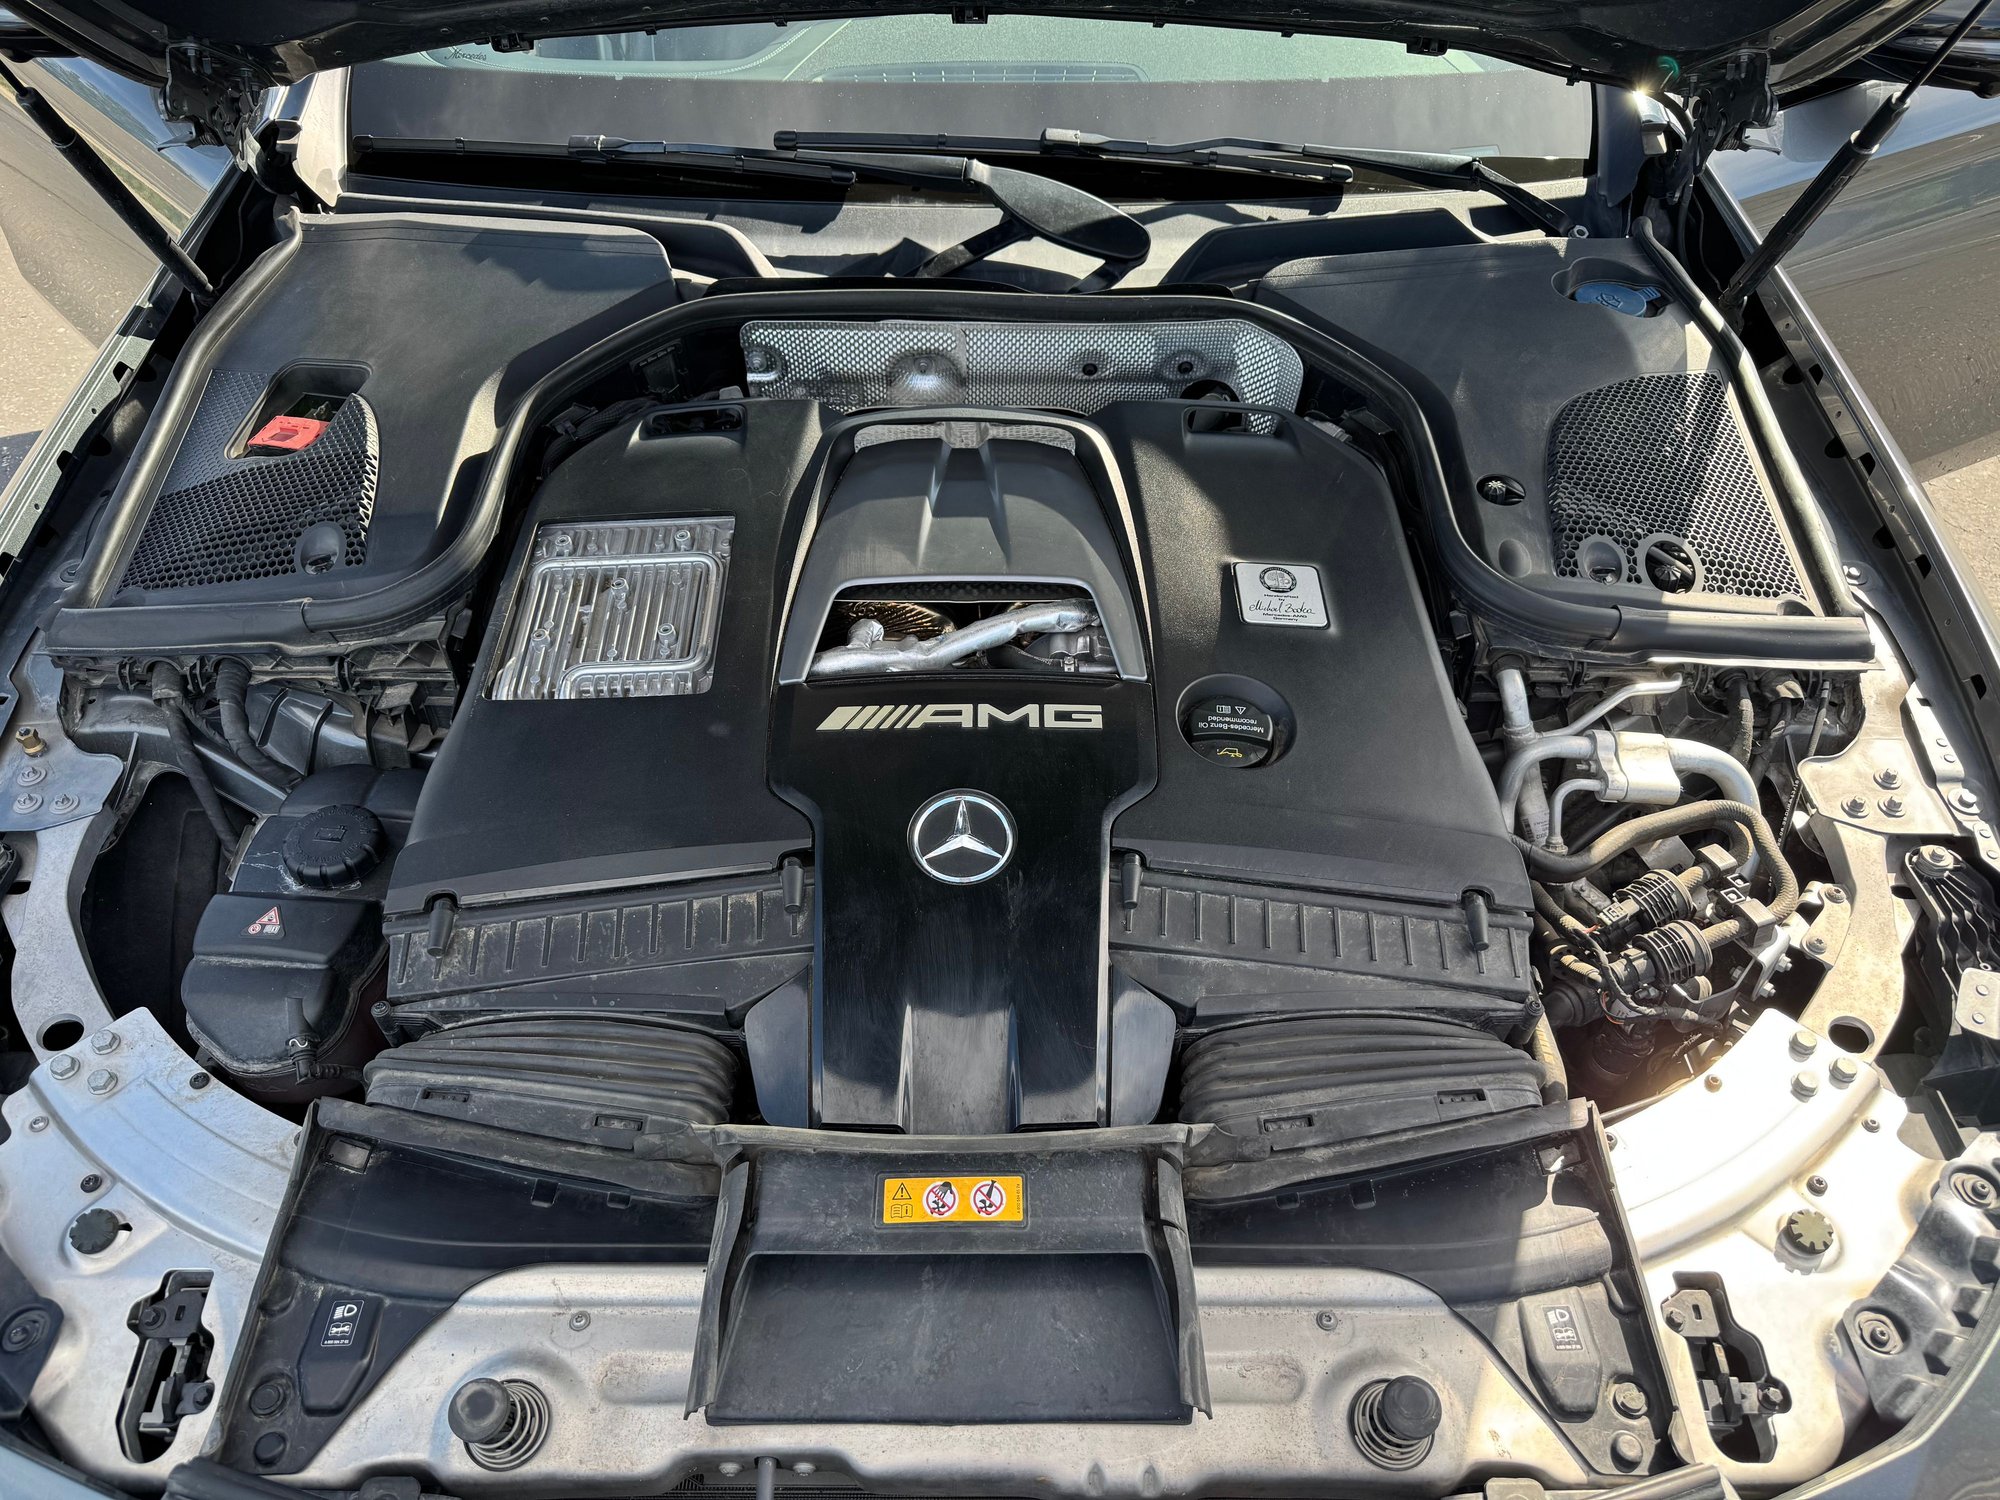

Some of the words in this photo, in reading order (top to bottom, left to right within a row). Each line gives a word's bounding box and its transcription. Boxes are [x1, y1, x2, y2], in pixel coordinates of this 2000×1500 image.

[444, 49, 487, 61] Mercedes
[907, 703, 1103, 729] AMG
[1207, 715, 1257, 725] recommended
[1210, 722, 1264, 733] Mercedes-Benz
